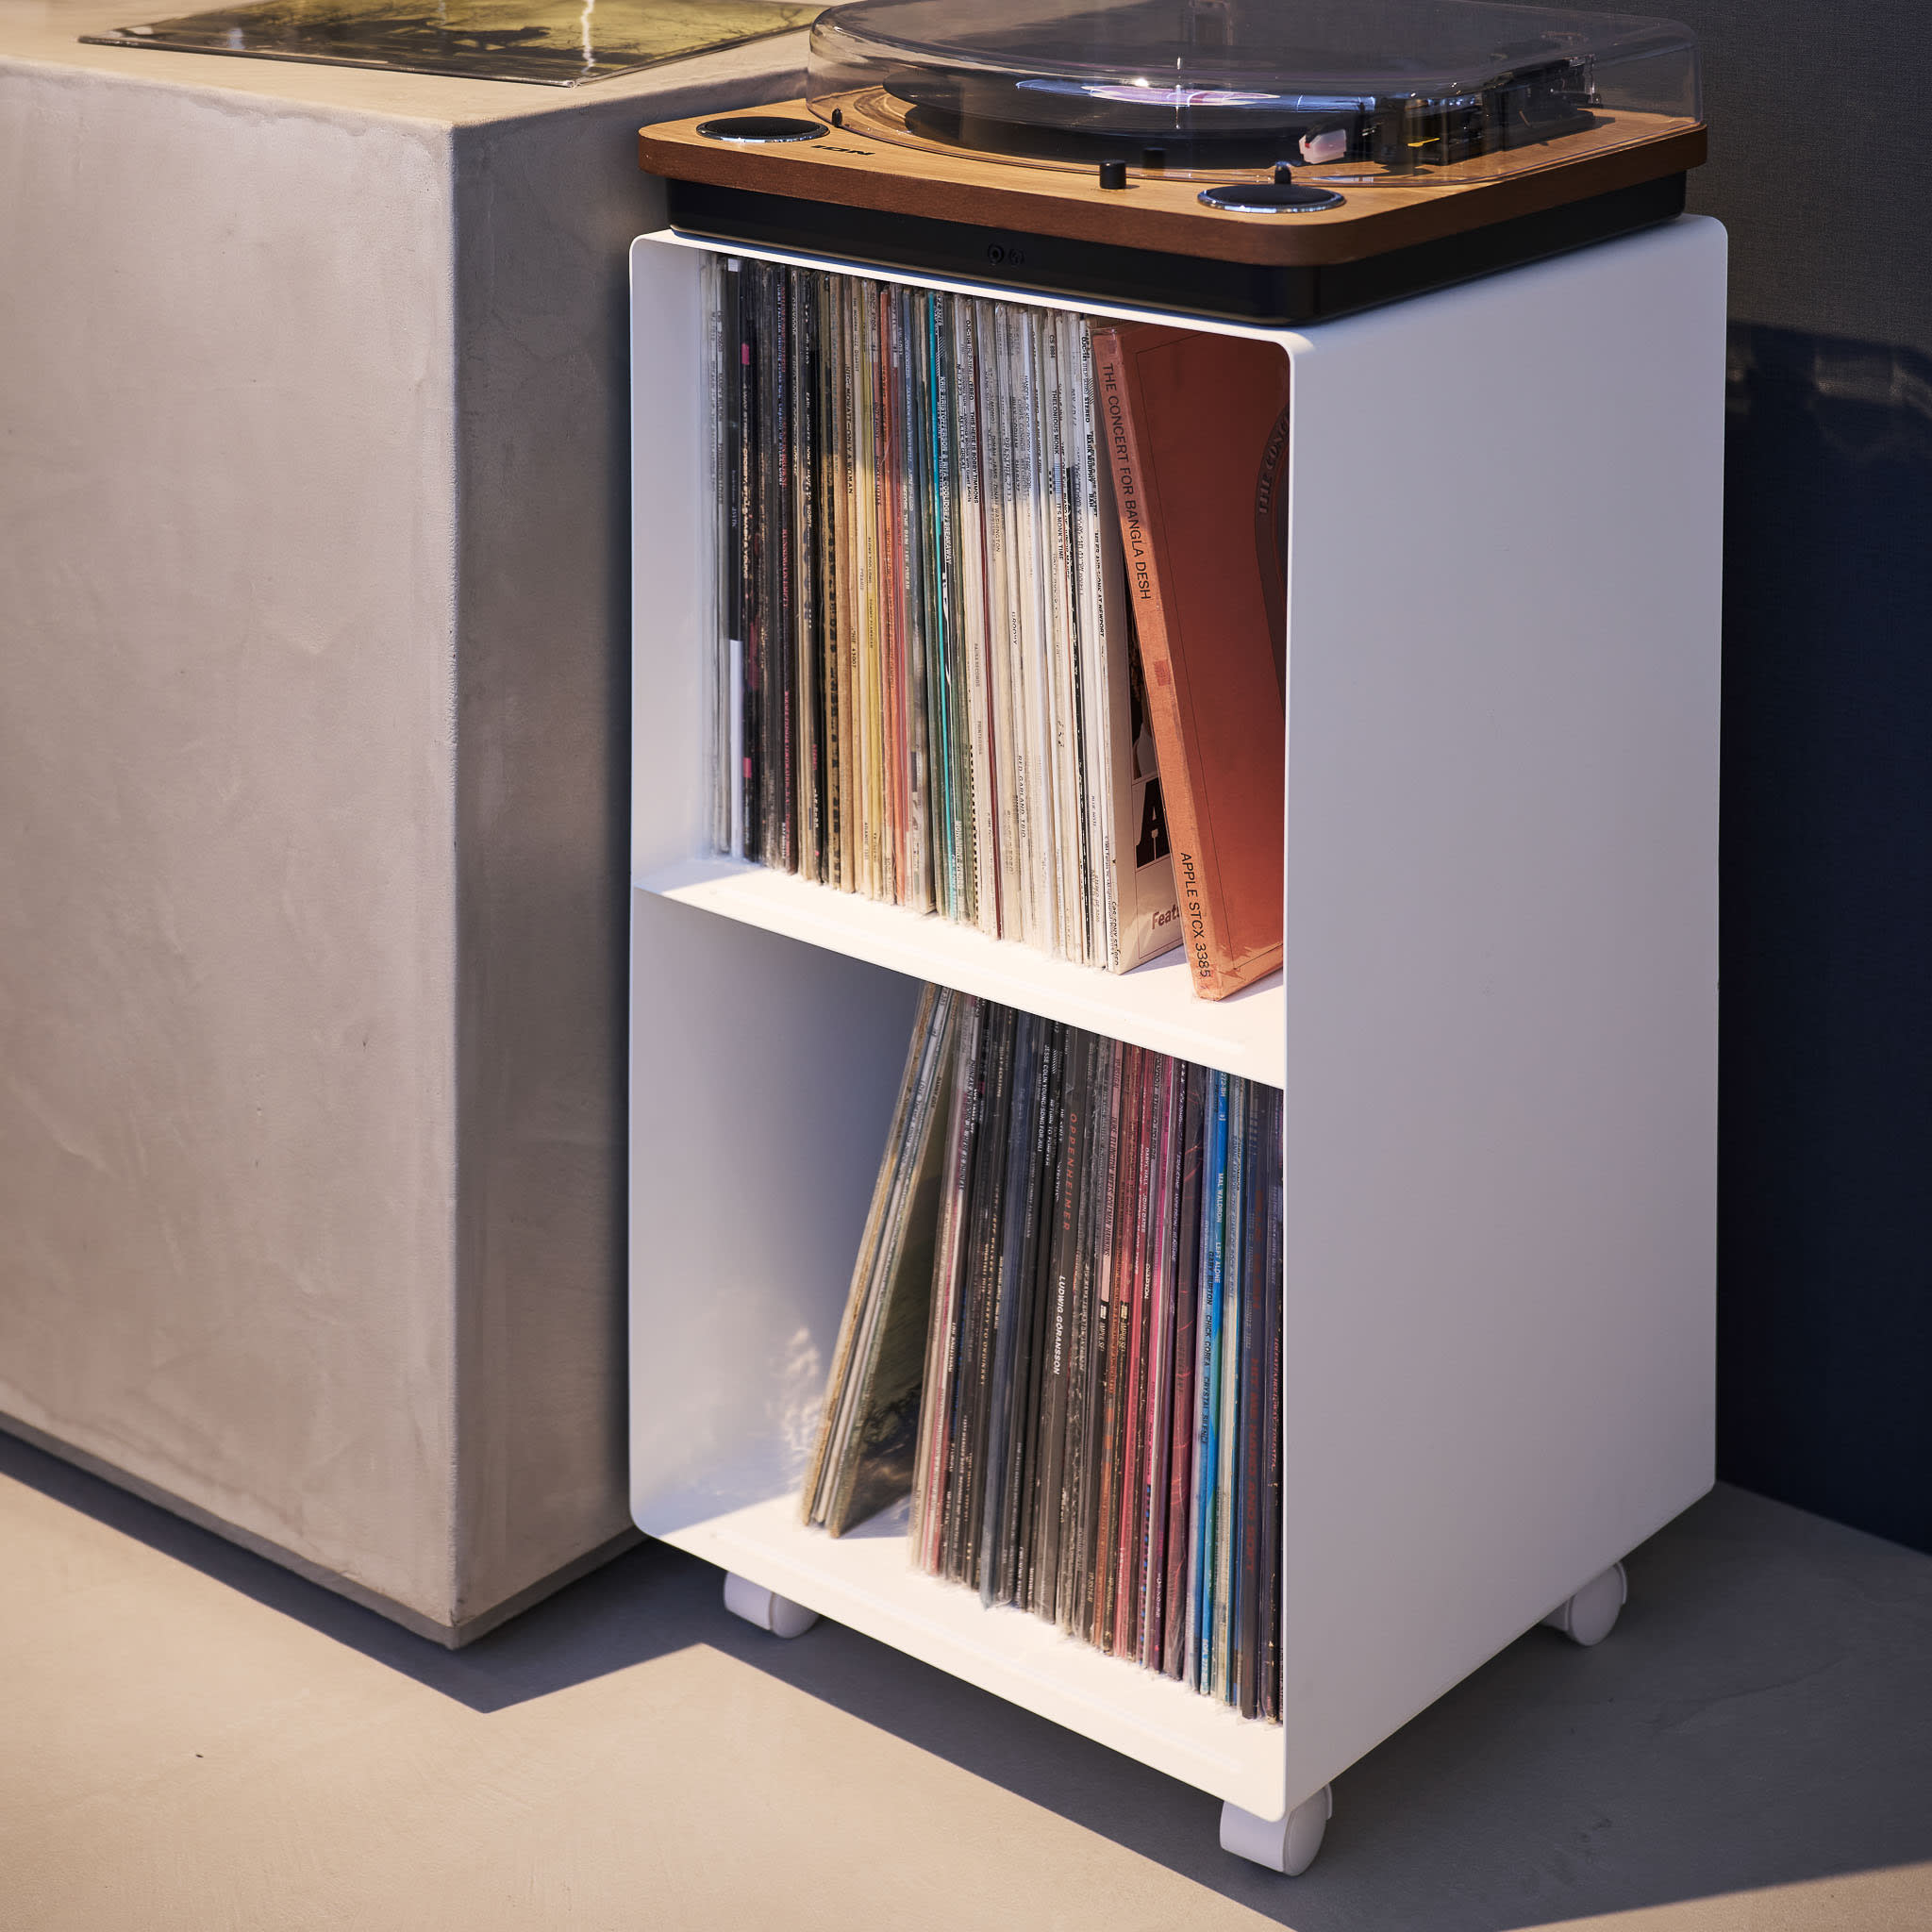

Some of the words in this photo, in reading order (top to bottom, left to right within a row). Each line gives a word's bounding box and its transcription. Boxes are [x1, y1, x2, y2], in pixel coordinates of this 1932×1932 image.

[810, 145, 875, 156] ION
[1049, 335, 1055, 343] CS
[1103, 364, 1116, 391] THE
[1108, 394, 1128, 460] CONCERT
[1119, 468, 1134, 495] FOR
[1124, 501, 1144, 557] BANGLA
[1134, 562, 1151, 600] DESH
[1180, 852, 1198, 897] APPLE
[1189, 902, 1205, 938] STCX
[1195, 942, 1211, 977] 3385
[1039, 1084, 1047, 1124] YOUNG/SONG
[1110, 1117, 1119, 1132] DUKE
[1063, 1113, 1077, 1231] OPPENHEIMER
[1108, 1136, 1117, 1174] ELLINGTON
[1106, 1197, 1114, 1225] COLEMAN
[1104, 1227, 1112, 1256] HAWKINS
[1057, 1275, 1066, 1312] LUDWIG
[1053, 1316, 1063, 1374] GÖRANSSON
[1250, 1393, 1257, 1419] ME
[1248, 1424, 1257, 1474] HARD
[1247, 1480, 1256, 1519] AND
[1246, 1524, 1255, 1574] SOFT
